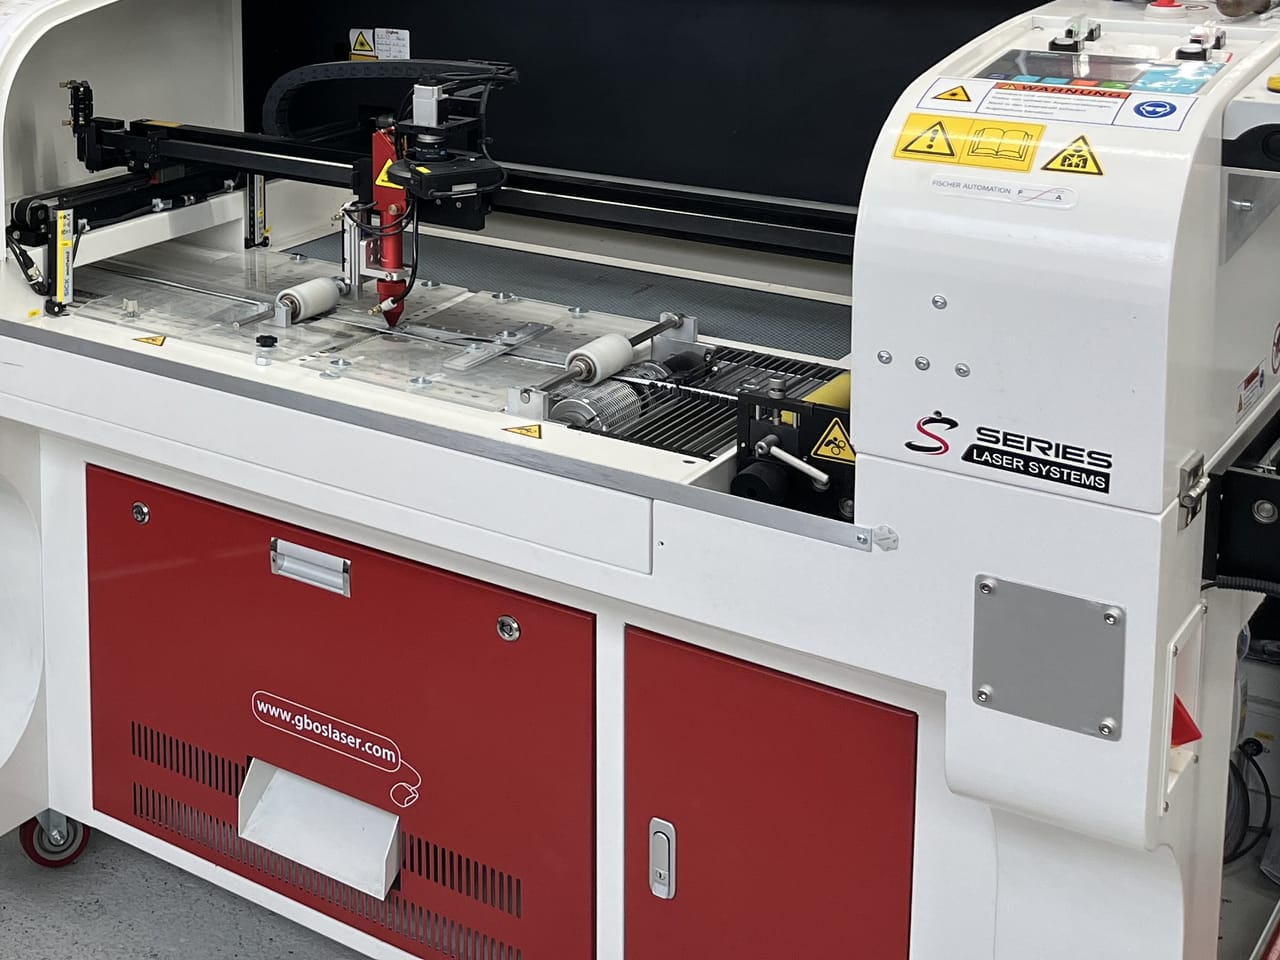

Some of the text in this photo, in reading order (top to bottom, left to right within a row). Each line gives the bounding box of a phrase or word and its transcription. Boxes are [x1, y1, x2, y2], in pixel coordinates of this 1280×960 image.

[1021, 85, 1122, 98] WARNUNG
[932, 179, 961, 188] FISCHER
[962, 183, 1011, 194] AUTOMATION
[976, 426, 1113, 469] SERIES
[973, 448, 1106, 489] LASER SYSTEMS
[256, 699, 396, 763] www.gboslaser.com
